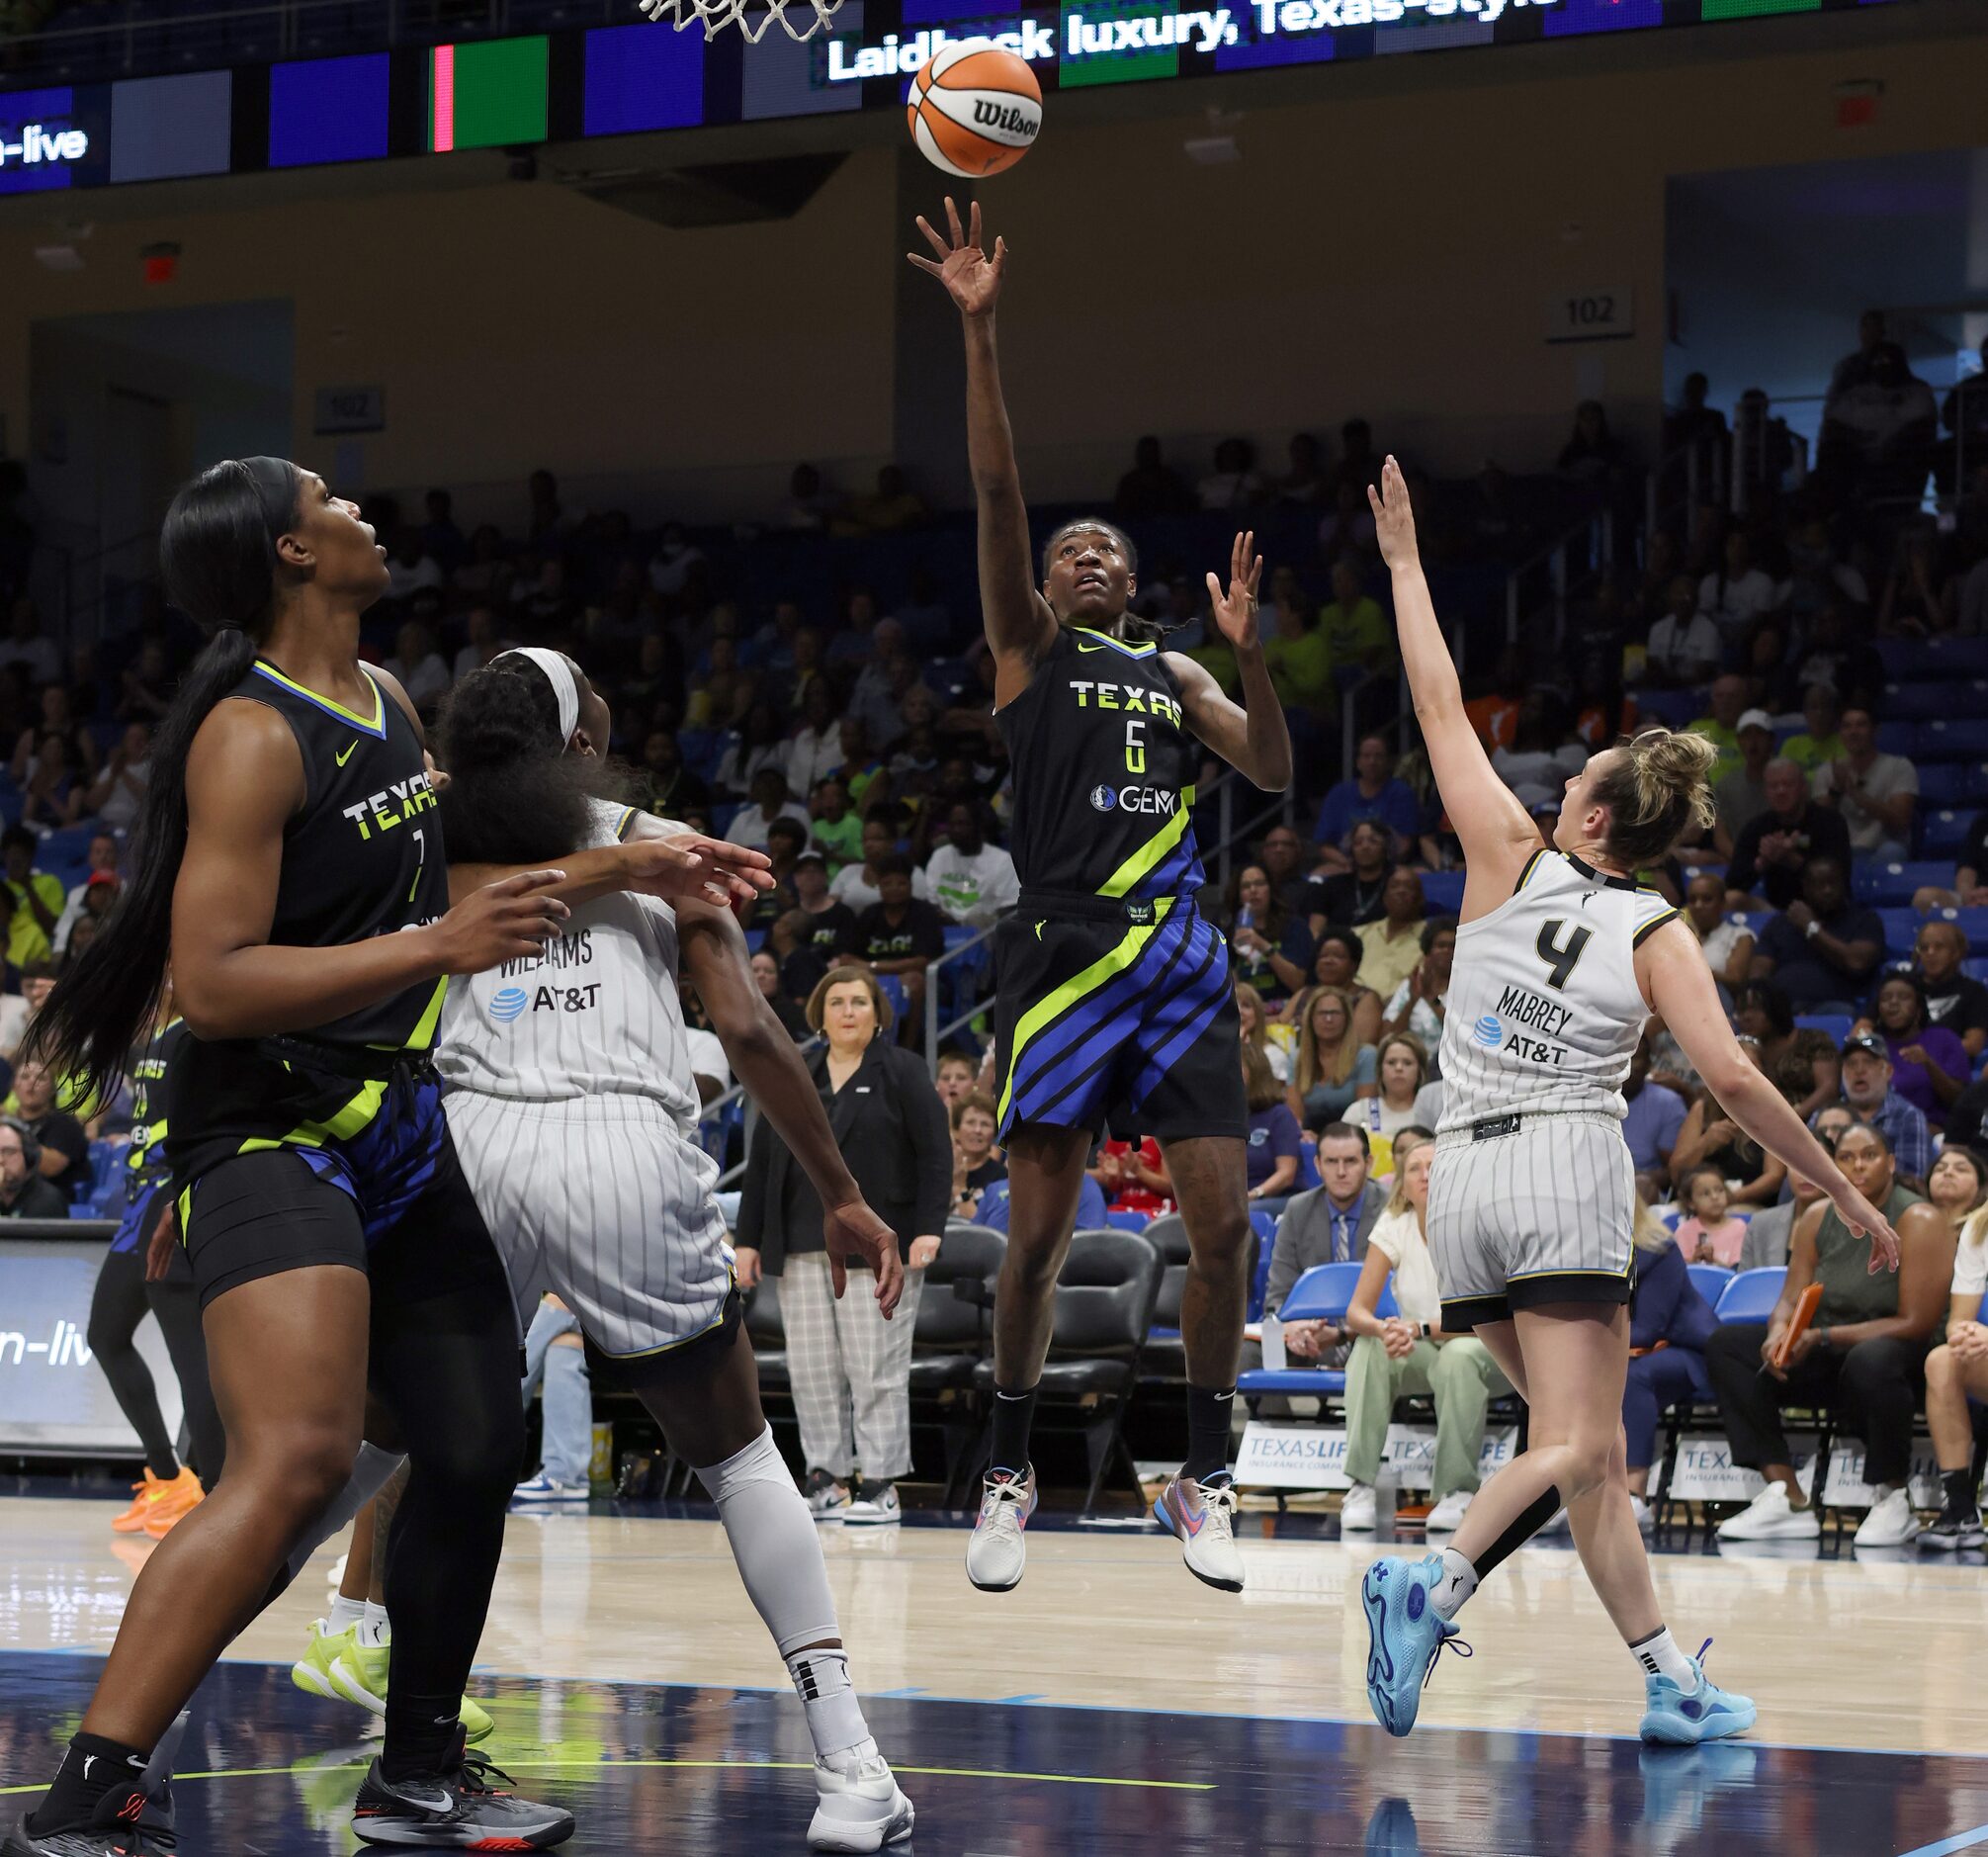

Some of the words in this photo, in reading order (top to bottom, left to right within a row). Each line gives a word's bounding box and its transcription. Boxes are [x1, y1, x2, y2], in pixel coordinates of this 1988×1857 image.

[1068, 9, 1238, 55] luxury,
[974, 98, 1040, 136] Wilson
[1567, 296, 1613, 324] 102
[1070, 680, 1182, 730] TEXAS
[1125, 720, 1146, 774] 6
[1119, 785, 1176, 817] GEM
[408, 829, 425, 903] 7
[1534, 919, 1595, 993] 4
[532, 983, 602, 1014] AT&T
[1496, 986, 1573, 1036] MABREY
[1504, 1033, 1568, 1065] AT&T
[1251, 1438, 1347, 1458] TEXASLIF
